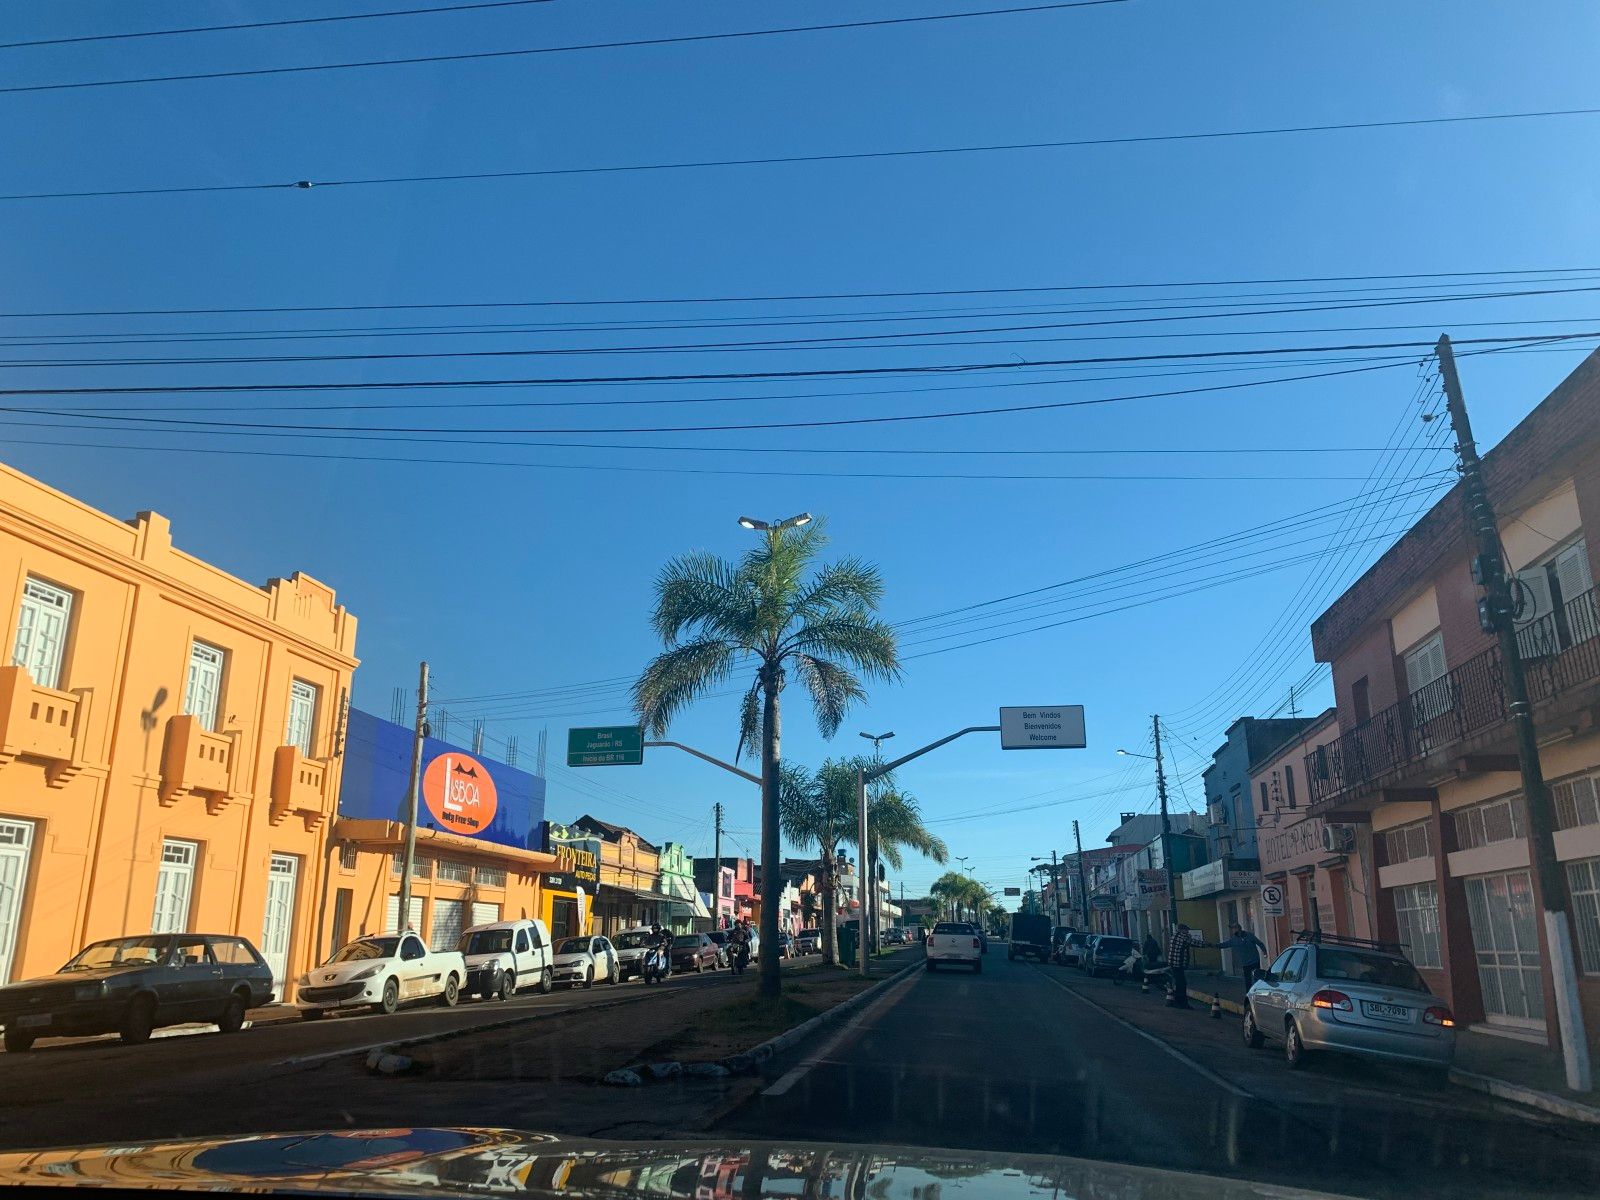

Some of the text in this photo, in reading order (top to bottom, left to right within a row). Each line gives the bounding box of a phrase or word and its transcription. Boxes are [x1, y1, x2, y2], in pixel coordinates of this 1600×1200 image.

[1022, 711, 1061, 719] Bem Vindos
[1024, 722, 1062, 730] Bienvenidos
[455, 814, 466, 825] Free
[467, 816, 480, 829] Shop
[556, 844, 597, 869] FRONTEIRA
